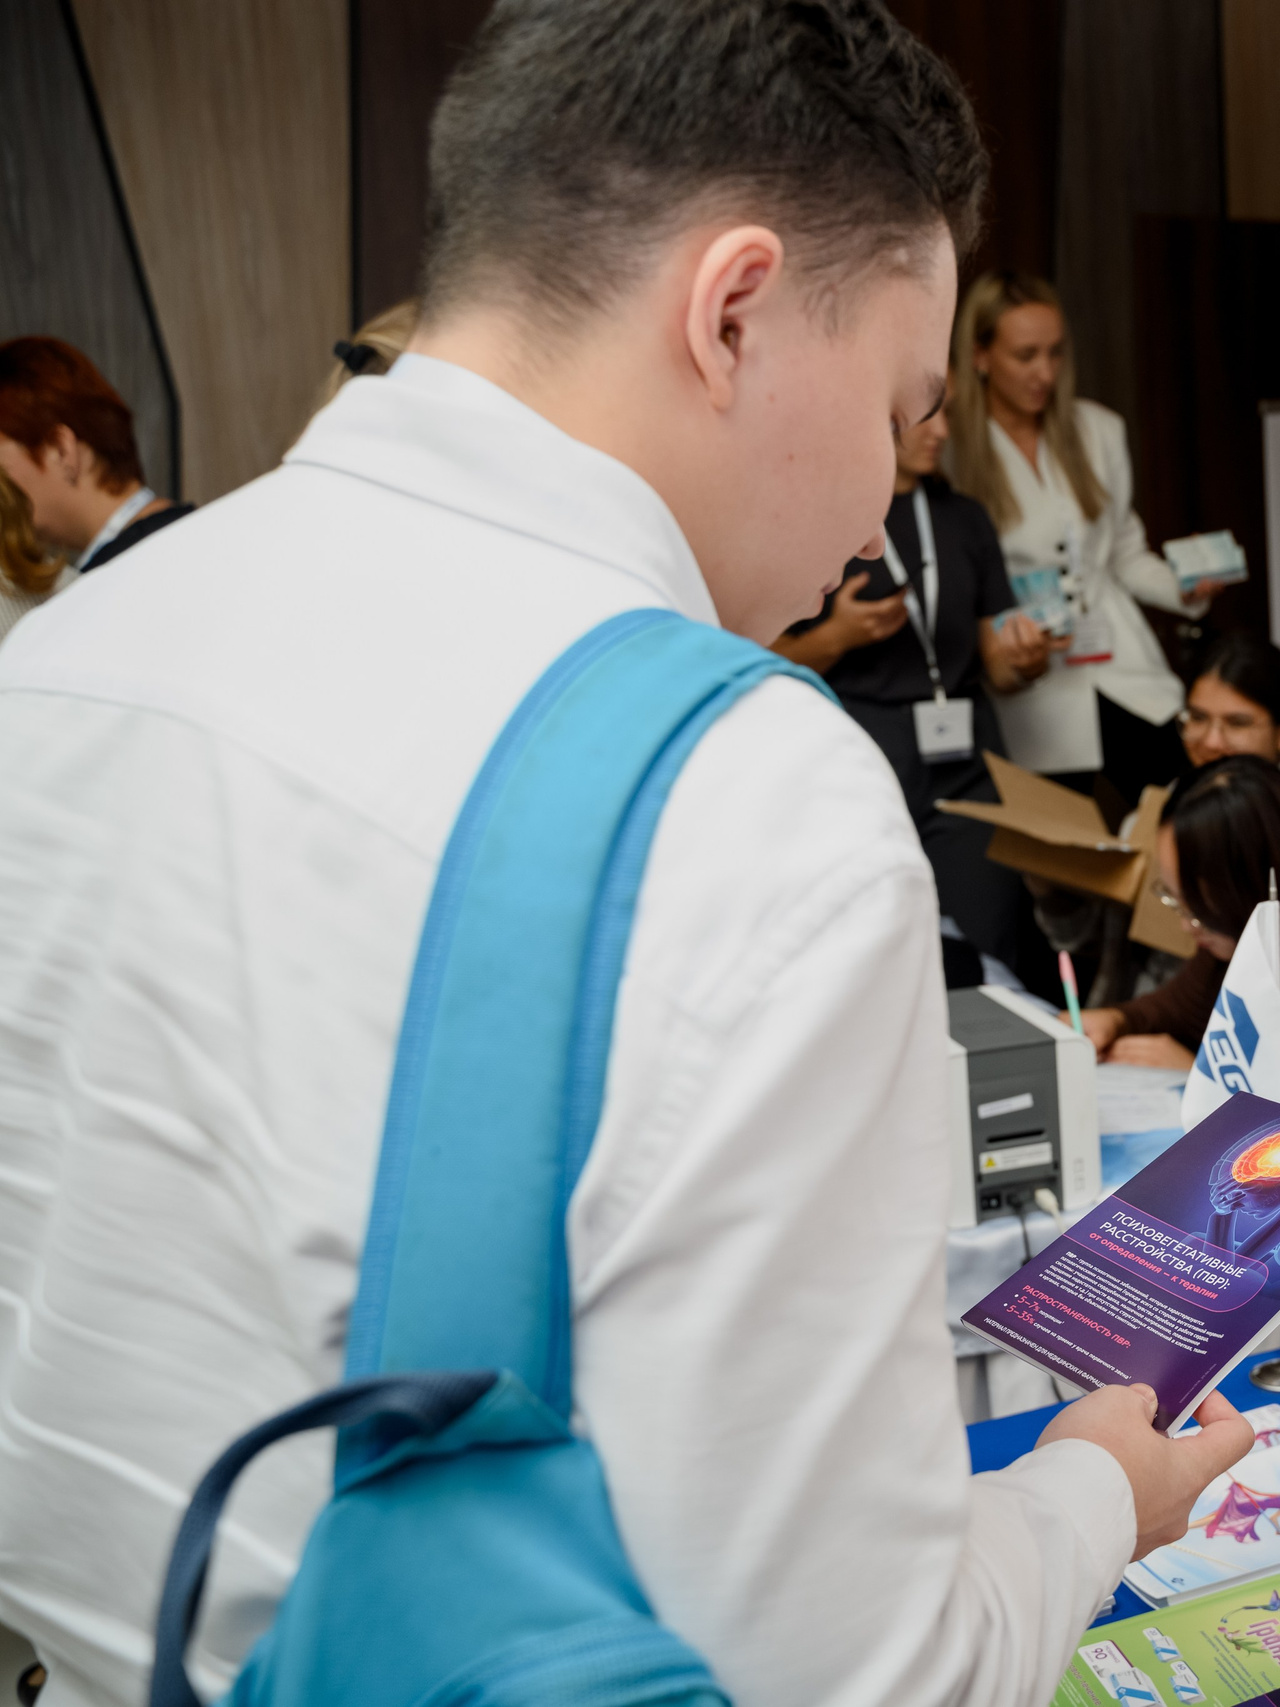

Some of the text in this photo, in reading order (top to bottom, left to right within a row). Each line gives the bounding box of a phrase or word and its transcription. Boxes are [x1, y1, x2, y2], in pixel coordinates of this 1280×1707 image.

[1065, 1251, 1077, 1259] ПВР
[1089, 1231, 1102, 1242] от
[1101, 1237, 1163, 1274] определения
[1171, 1275, 1178, 1283] к
[1178, 1278, 1219, 1300] терапии
[1099, 1221, 1231, 1291] РАССТРОЙСТВА (ПВР):
[1111, 1211, 1247, 1279] ПСИХОВЕГЕТАТИВНЫЕ
[983, 1316, 1008, 1332] МАТЕРИАЛ
[1004, 1328, 1040, 1350] ПРЕДНАЗНАЧЕН
[1035, 1346, 1048, 1355] ДЛЯ
[1044, 1351, 1080, 1373] МЕДИЦИНСКИХ
[1022, 1284, 1132, 1349] РАСПРОСТРАНЕННОСТЬ ПВР:
[1032, 1321, 1052, 1334] случаев
[1055, 1334, 1075, 1346] приеме
[1075, 1345, 1091, 1356] врача
[1088, 1352, 1117, 1370] первичного
